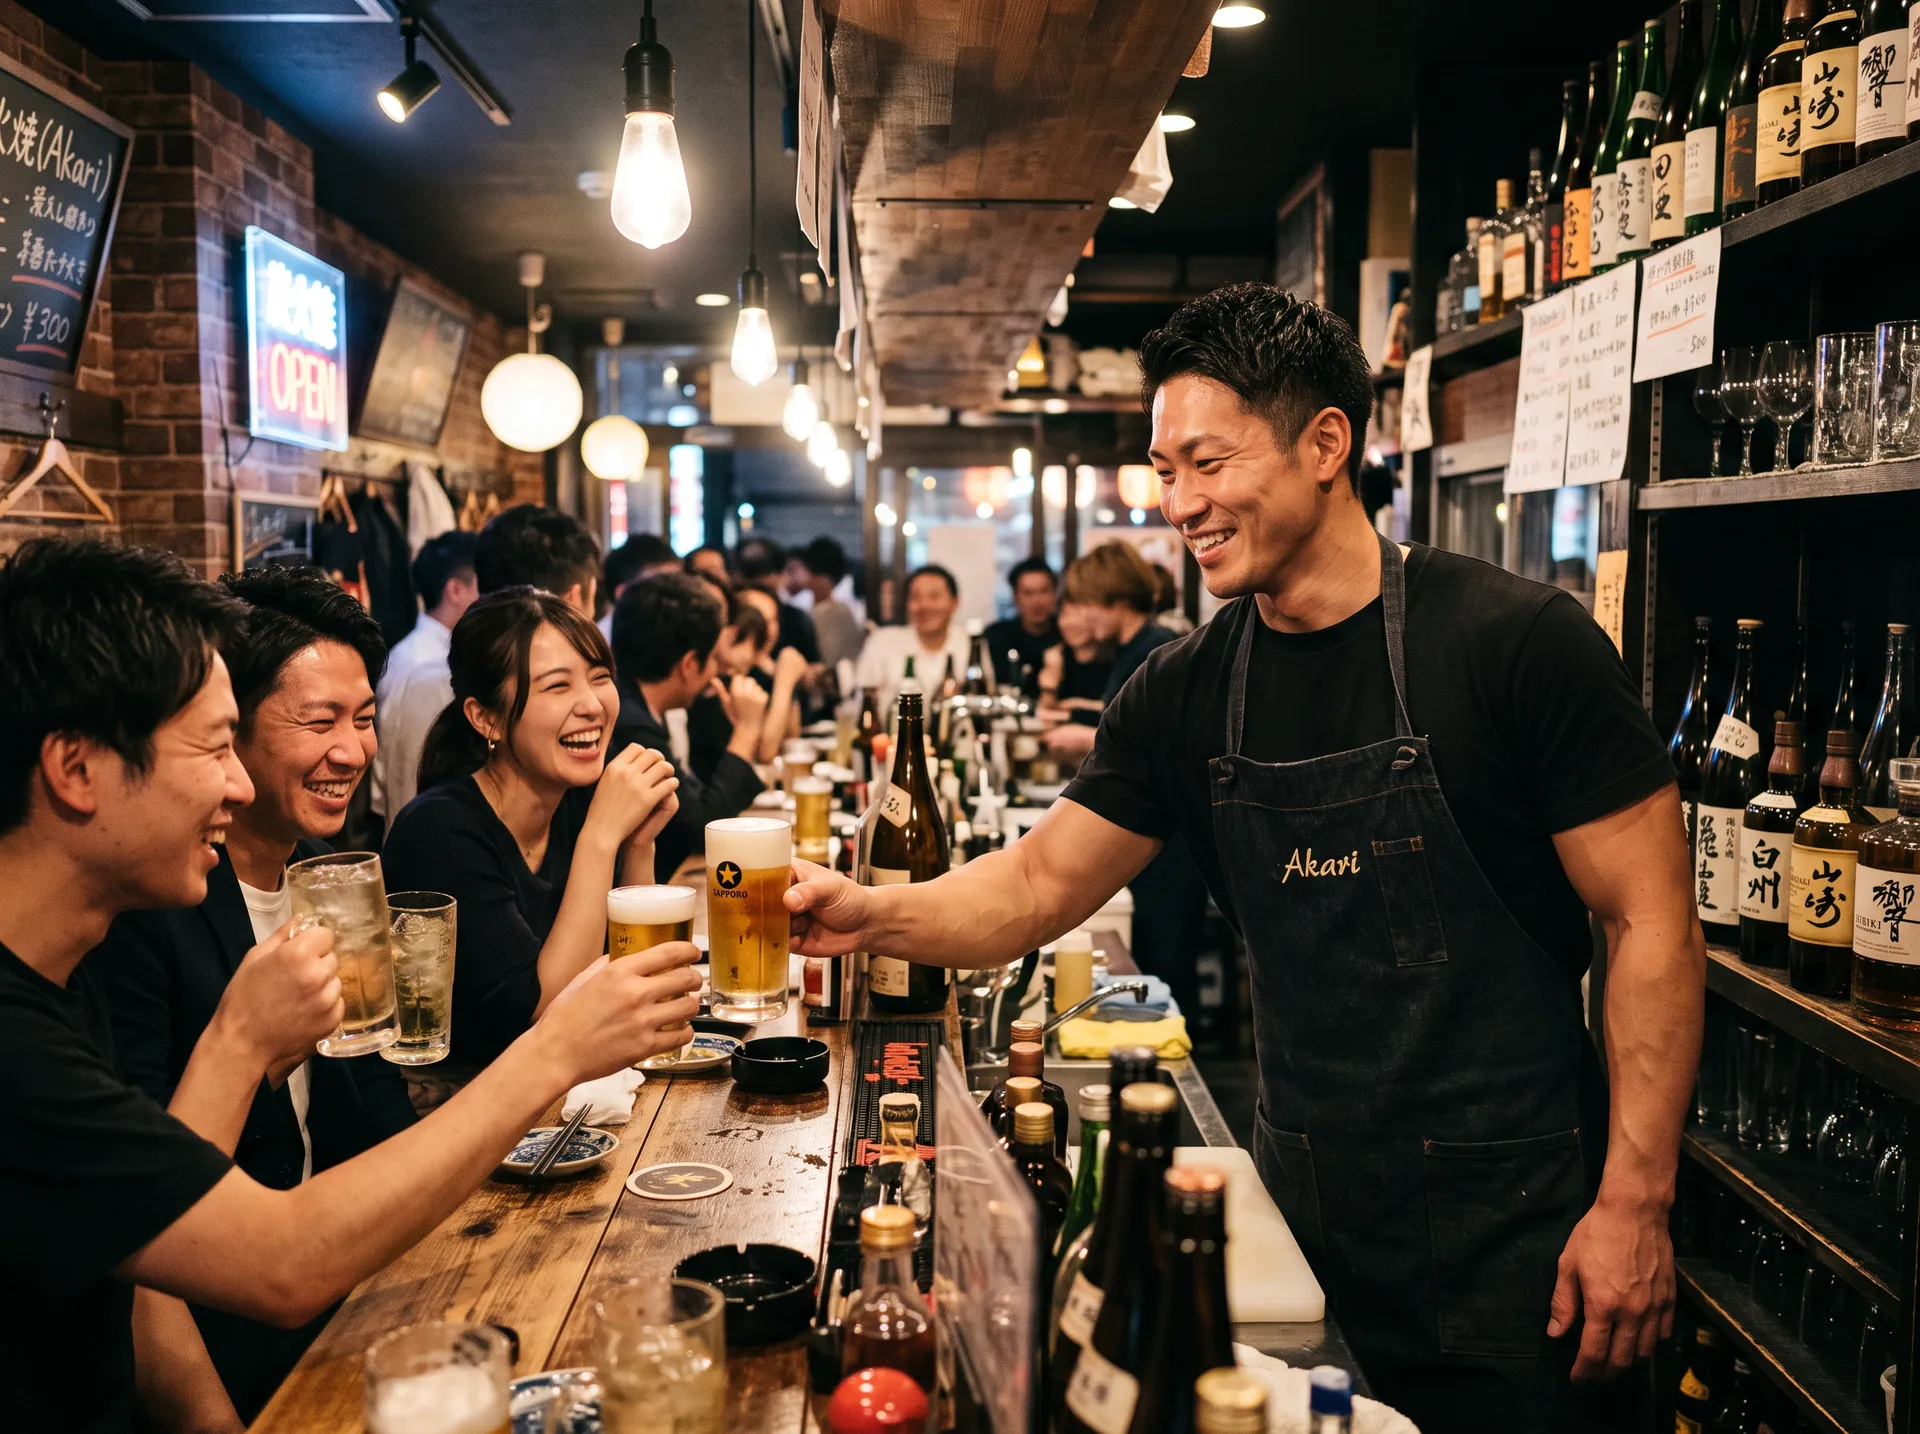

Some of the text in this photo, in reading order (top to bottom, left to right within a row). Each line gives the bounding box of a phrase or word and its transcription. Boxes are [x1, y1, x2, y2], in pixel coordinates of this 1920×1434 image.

[1808, 61, 1845, 130] 山崎
[1861, 44, 1906, 109] 響
[23, 301, 70, 343] ¥300
[1690, 334, 1707, 353] 500
[269, 342, 337, 424] OPEN
[713, 888, 748, 899] SAPPORO
[1281, 848, 1361, 884] Akari
[1748, 838, 1781, 910] 白州
[1805, 860, 1847, 929] 山崎
[1872, 879, 1920, 943] 響
